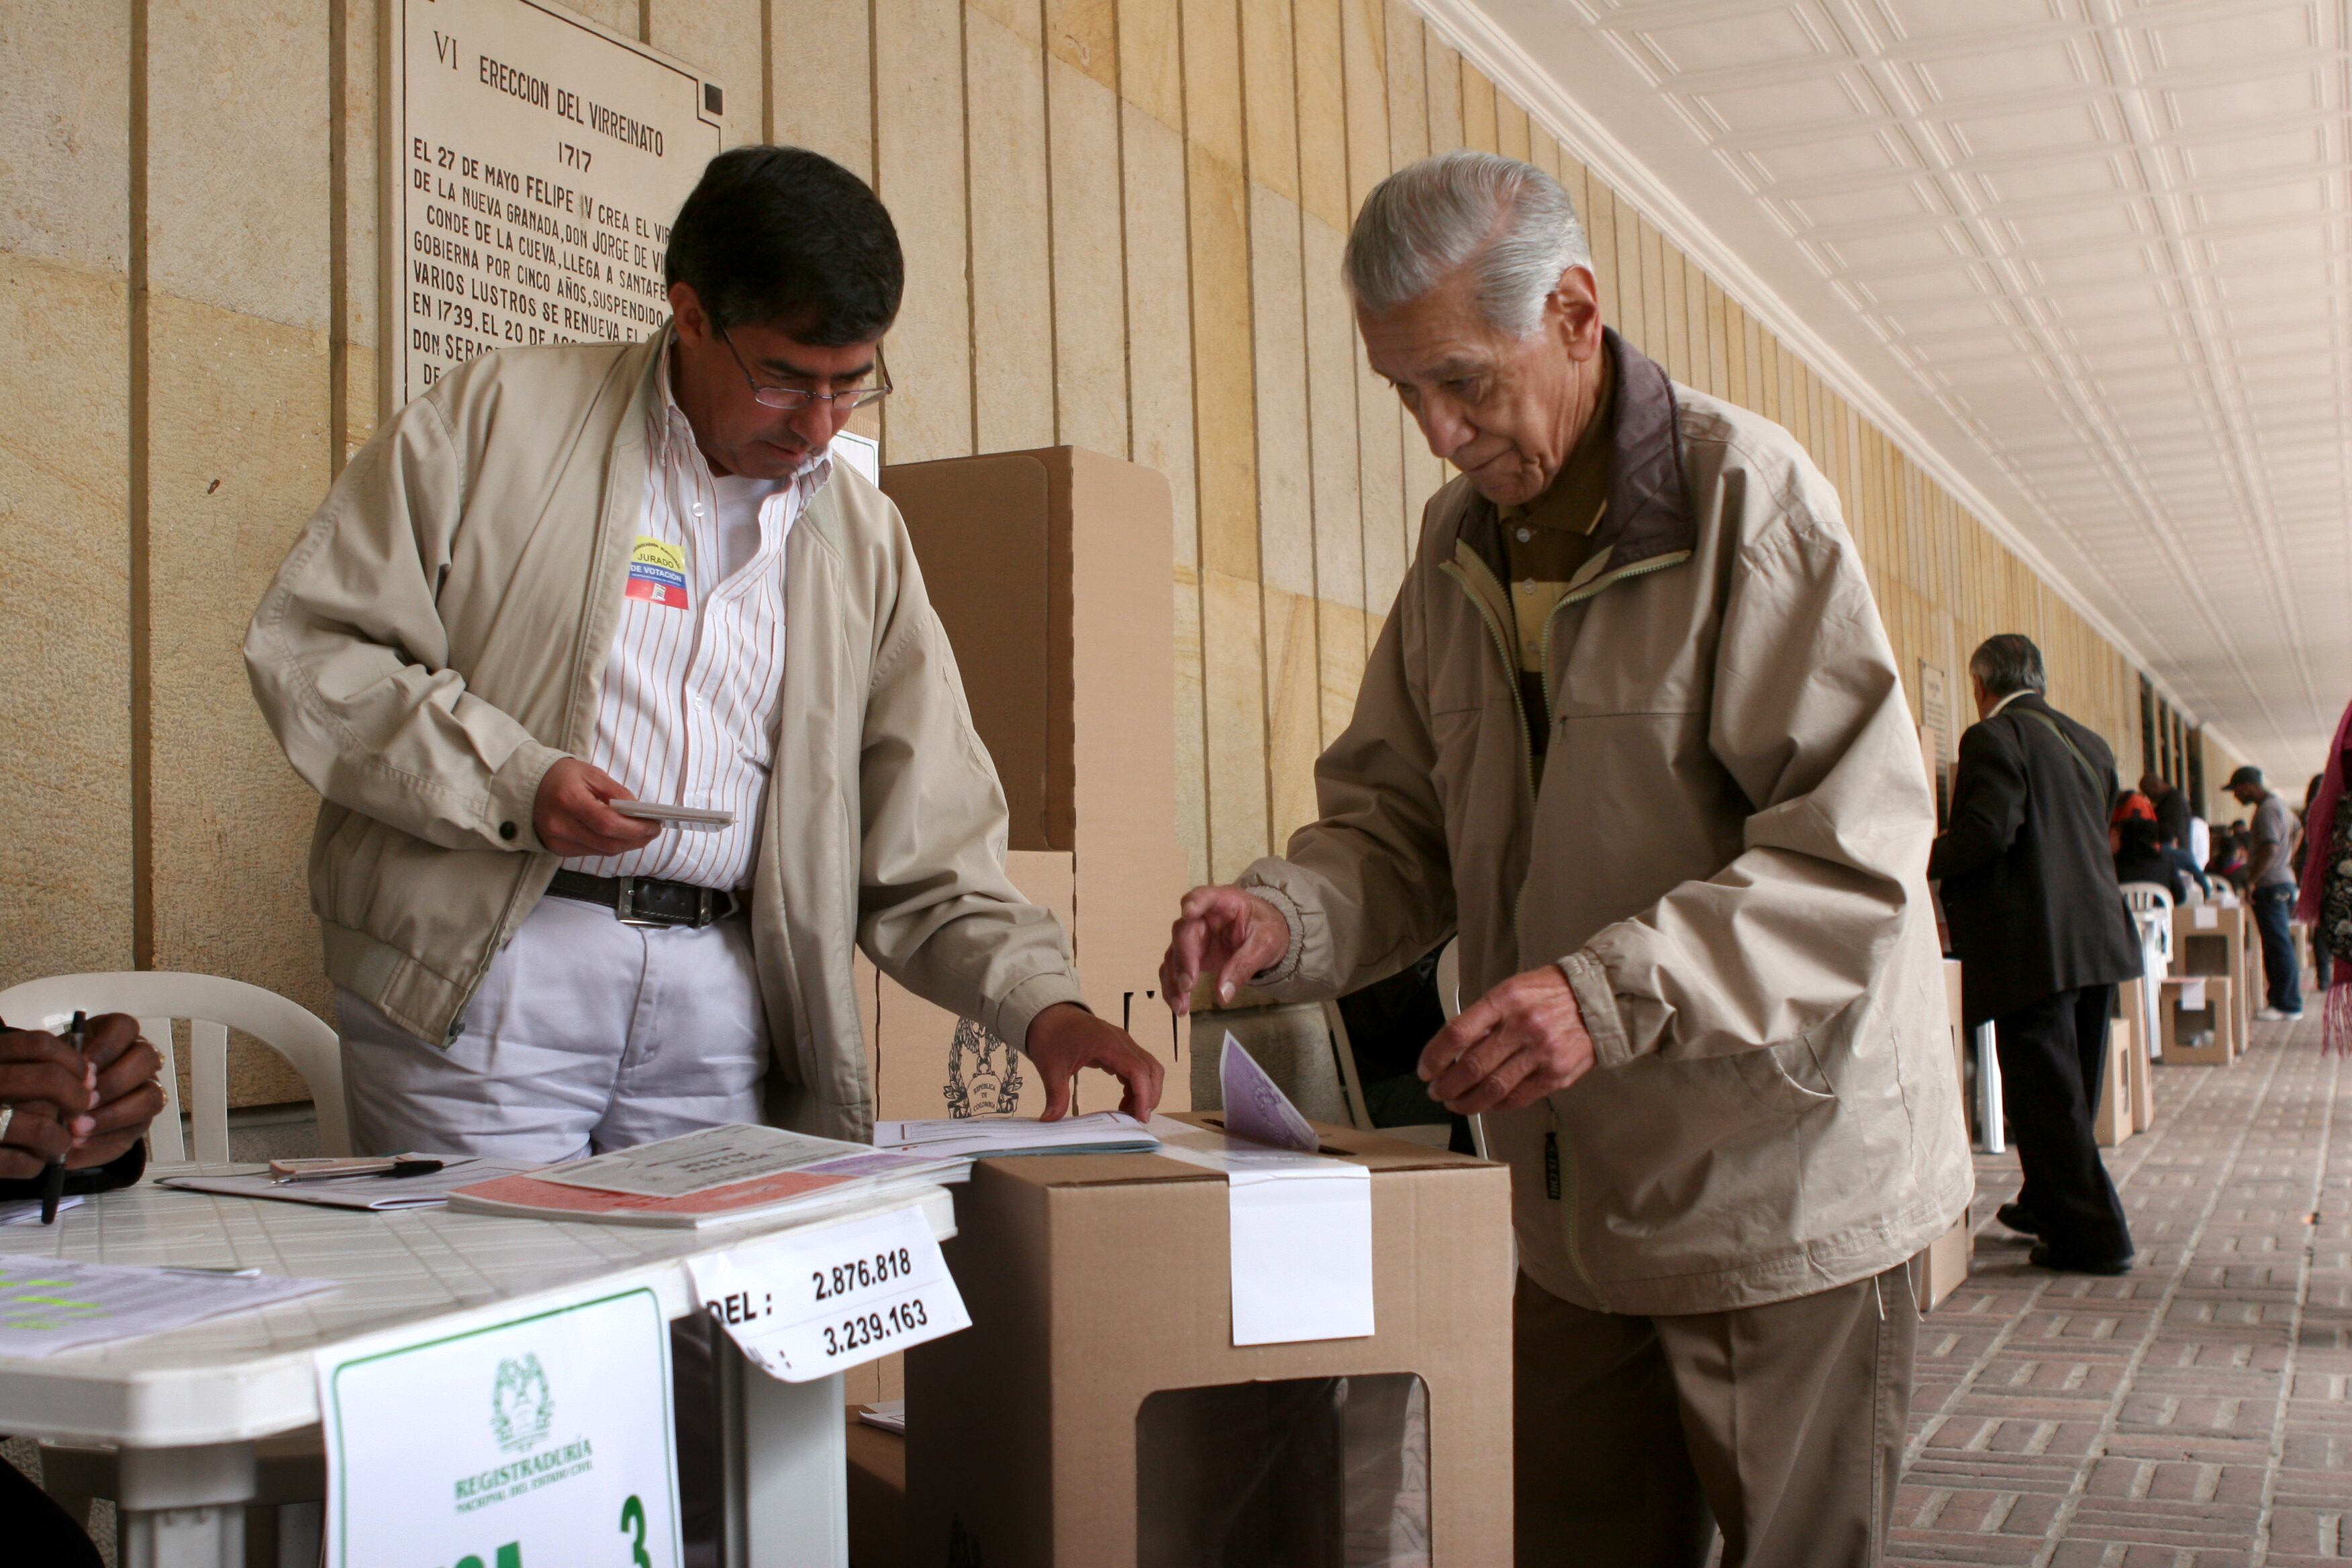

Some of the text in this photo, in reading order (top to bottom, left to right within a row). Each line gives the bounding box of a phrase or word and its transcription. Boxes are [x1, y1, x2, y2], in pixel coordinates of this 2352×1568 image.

[434, 30, 457, 70] VI
[480, 54, 663, 157] ERECCION DEL VIRREINATO
[559, 142, 591, 173] 1717
[414, 137, 432, 163] EL
[438, 146, 455, 170] 27
[462, 156, 479, 180] DE
[485, 164, 519, 193] MAYO
[527, 175, 573, 213] FELIPE
[599, 204, 630, 232] CREA
[636, 217, 650, 238] EL
[414, 168, 430, 193] DE
[438, 177, 456, 202] LA
[463, 186, 501, 219] NUEVA
[566, 224, 587, 248] DON
[593, 230, 628, 262] JORGE
[635, 244, 647, 268] DE
[414, 231, 479, 270] GOBIERNA
[487, 254, 510, 280] POR
[518, 264, 550, 292] CINCO
[593, 290, 663, 328] SUSPENDIDO
[427, 205, 469, 236] CONDE
[475, 220, 491, 244] DE
[497, 228, 513, 252] LA
[564, 251, 600, 280] LLEGA
[607, 266, 613, 285] A
[620, 270, 666, 301] SANTAFE
[413, 260, 464, 295] VARIOS
[472, 279, 536, 317] LUSTROS
[543, 302, 559, 324] SE
[565, 307, 620, 342] RENUEVA
[413, 292, 431, 317] EN
[483, 312, 499, 336] EL
[505, 320, 523, 343] 20
[413, 328, 440, 356] DON
[631, 565, 642, 573] DE
[638, 554, 674, 569] JURADO
[812, 1247, 912, 1304] 2.876.818
[824, 1299, 928, 1357] 3.239.163
[454, 1434, 593, 1500] REGISTRADURÍA
